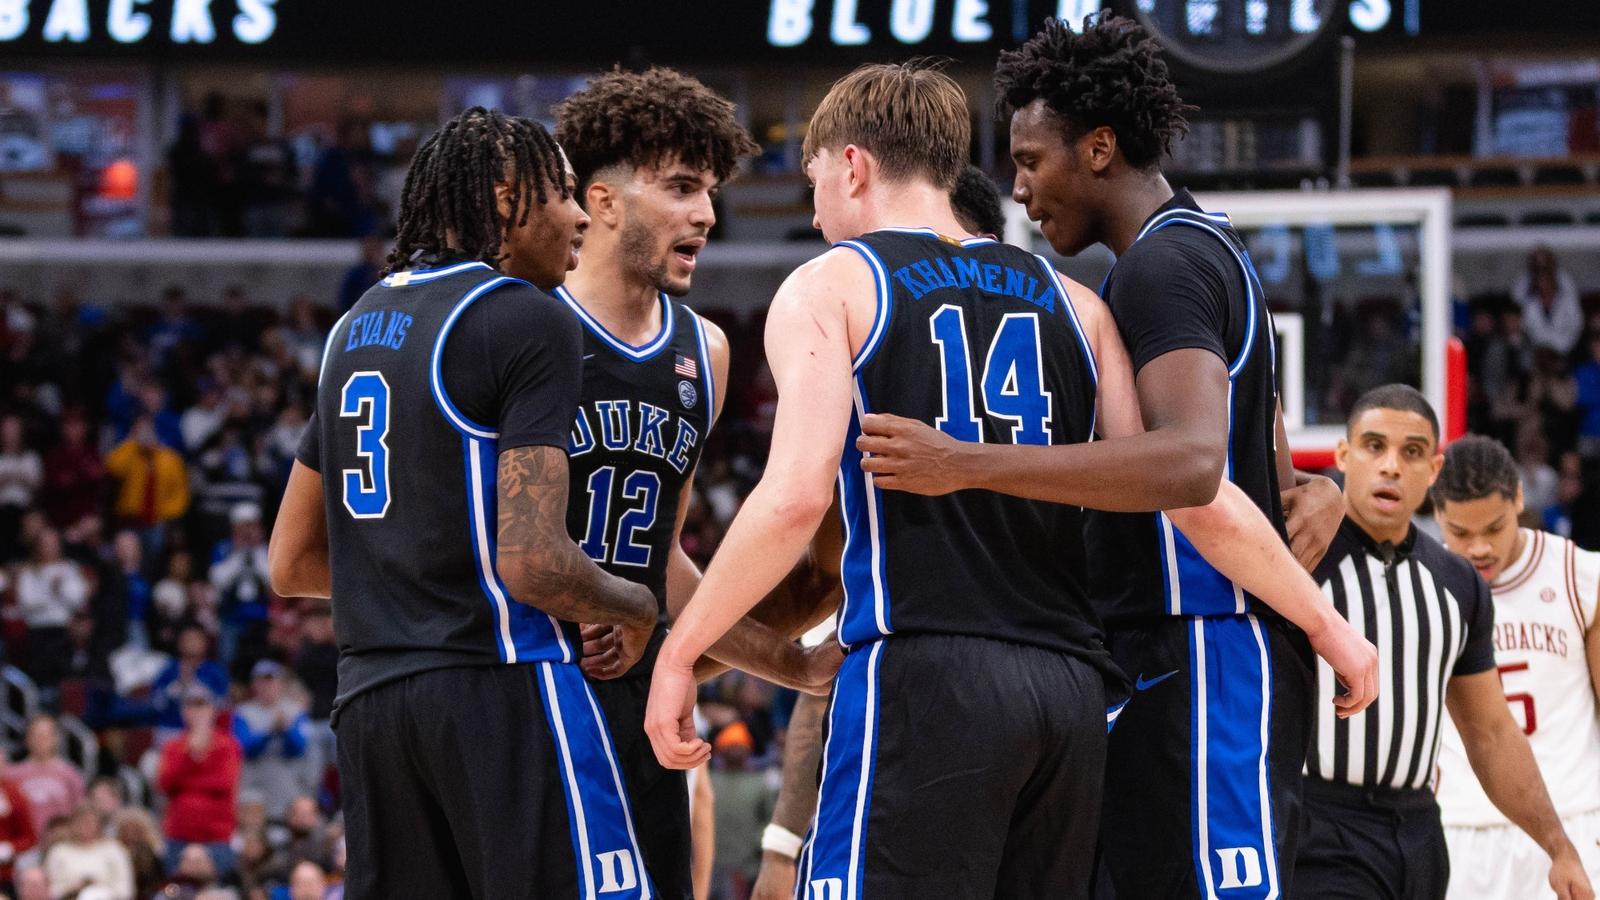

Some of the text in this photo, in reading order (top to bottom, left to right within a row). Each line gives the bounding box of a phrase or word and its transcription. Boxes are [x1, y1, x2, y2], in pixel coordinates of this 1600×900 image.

[766, 0, 993, 46] BLUE
[893, 256, 1056, 314] KHAMENIA
[345, 312, 414, 352] EVANS
[929, 303, 1053, 446] 14
[340, 371, 391, 519] 3
[569, 400, 698, 474] DUKE
[579, 465, 661, 567] 12
[596, 849, 637, 893] D
[1215, 846, 1263, 889] D
